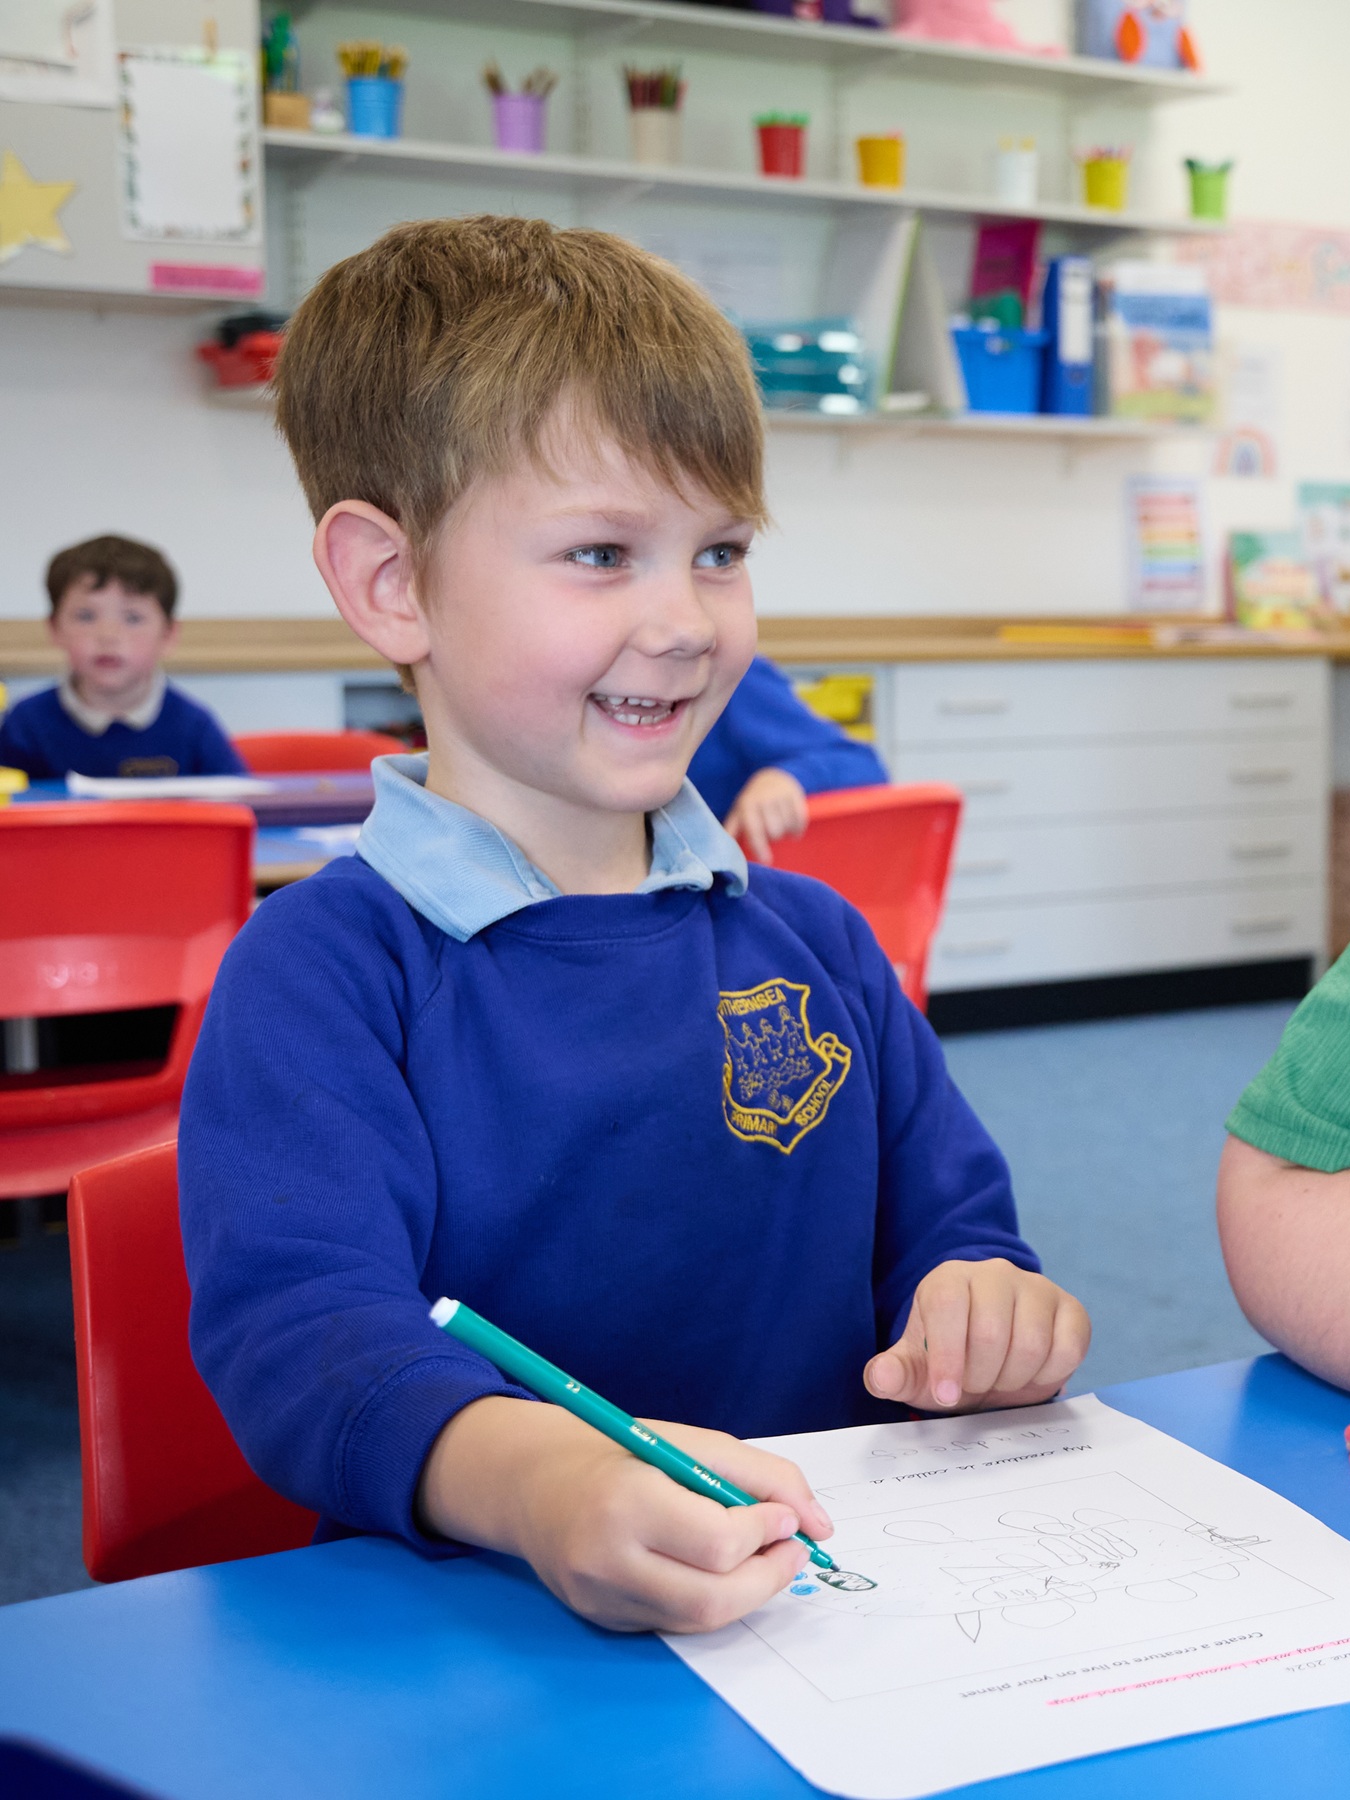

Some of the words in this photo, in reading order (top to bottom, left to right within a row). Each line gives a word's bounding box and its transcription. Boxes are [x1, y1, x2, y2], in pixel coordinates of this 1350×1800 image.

[794, 1079, 835, 1126] SCHOOL
[1063, 1445, 1093, 1453] My
[982, 1450, 1055, 1467] creature
[956, 1463, 975, 1471] is
[892, 1467, 948, 1482] called
[1213, 1631, 1264, 1647] Create
[1132, 1645, 1198, 1664] creature
[1082, 1663, 1111, 1674] live
[1284, 1659, 1327, 1673] 2024
[1056, 1669, 1077, 1678] on
[1017, 1675, 1053, 1687] your
[959, 1682, 1011, 1699] planet
